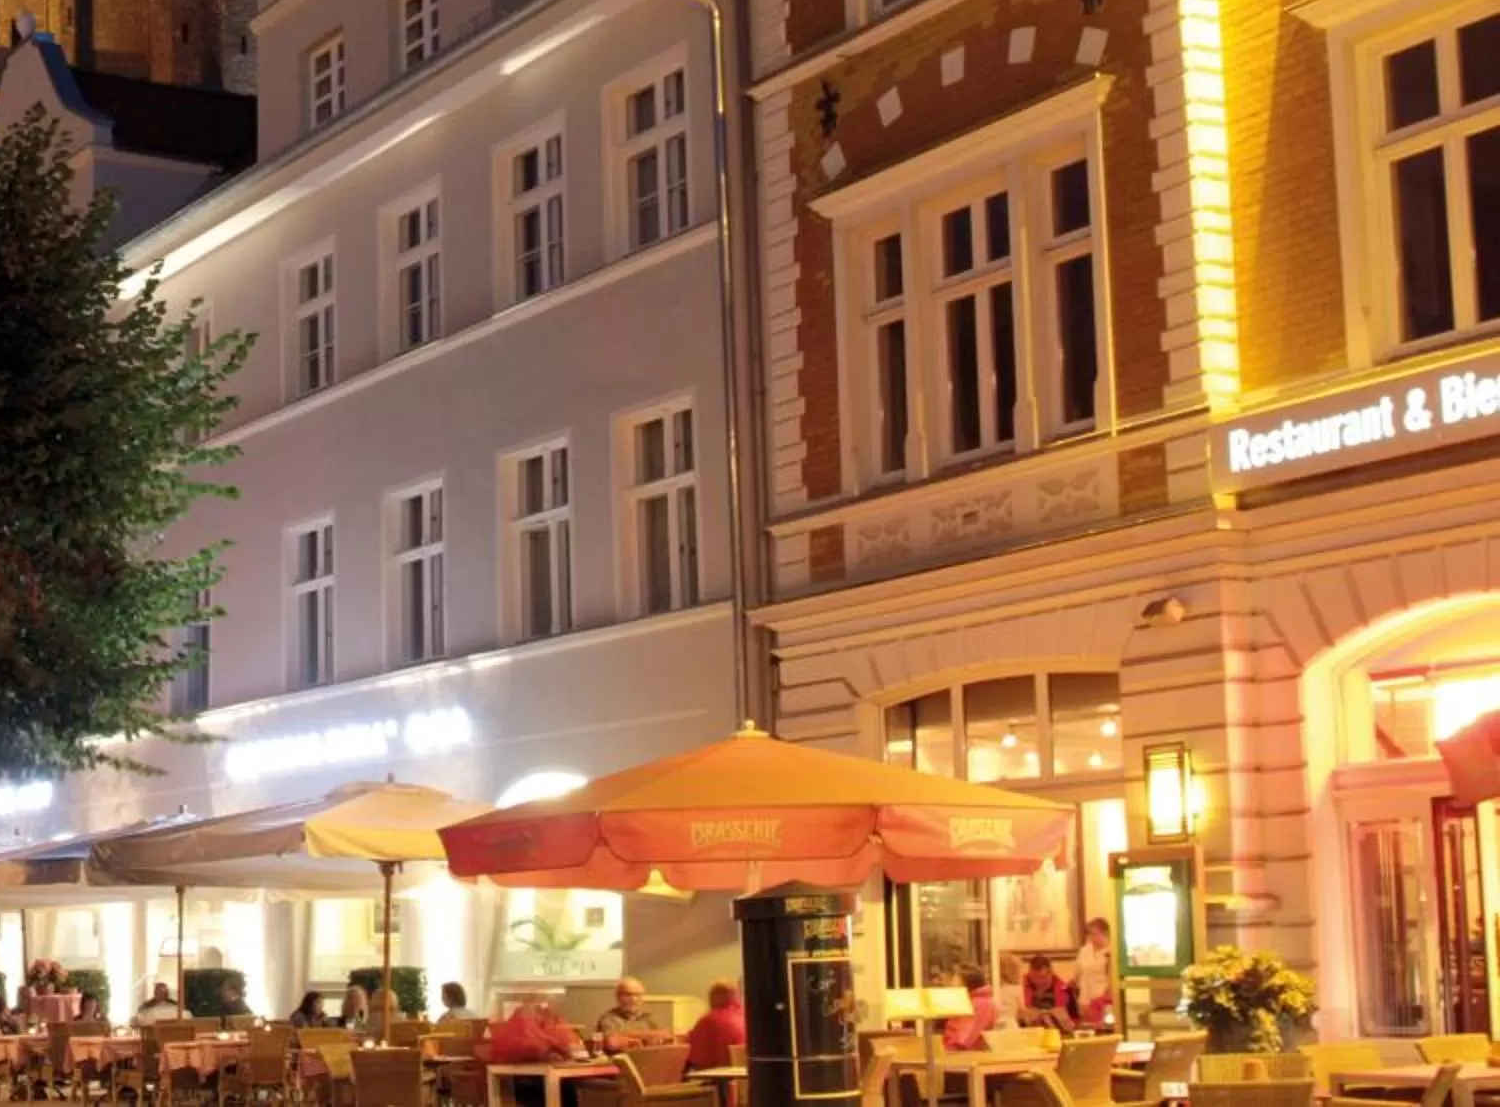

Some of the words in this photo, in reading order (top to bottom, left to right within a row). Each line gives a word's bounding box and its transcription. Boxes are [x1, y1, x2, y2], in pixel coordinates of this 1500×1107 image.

[1228, 396, 1396, 474] Restaurant
[1403, 386, 1433, 432] &
[1440, 370, 1500, 425] Bie
